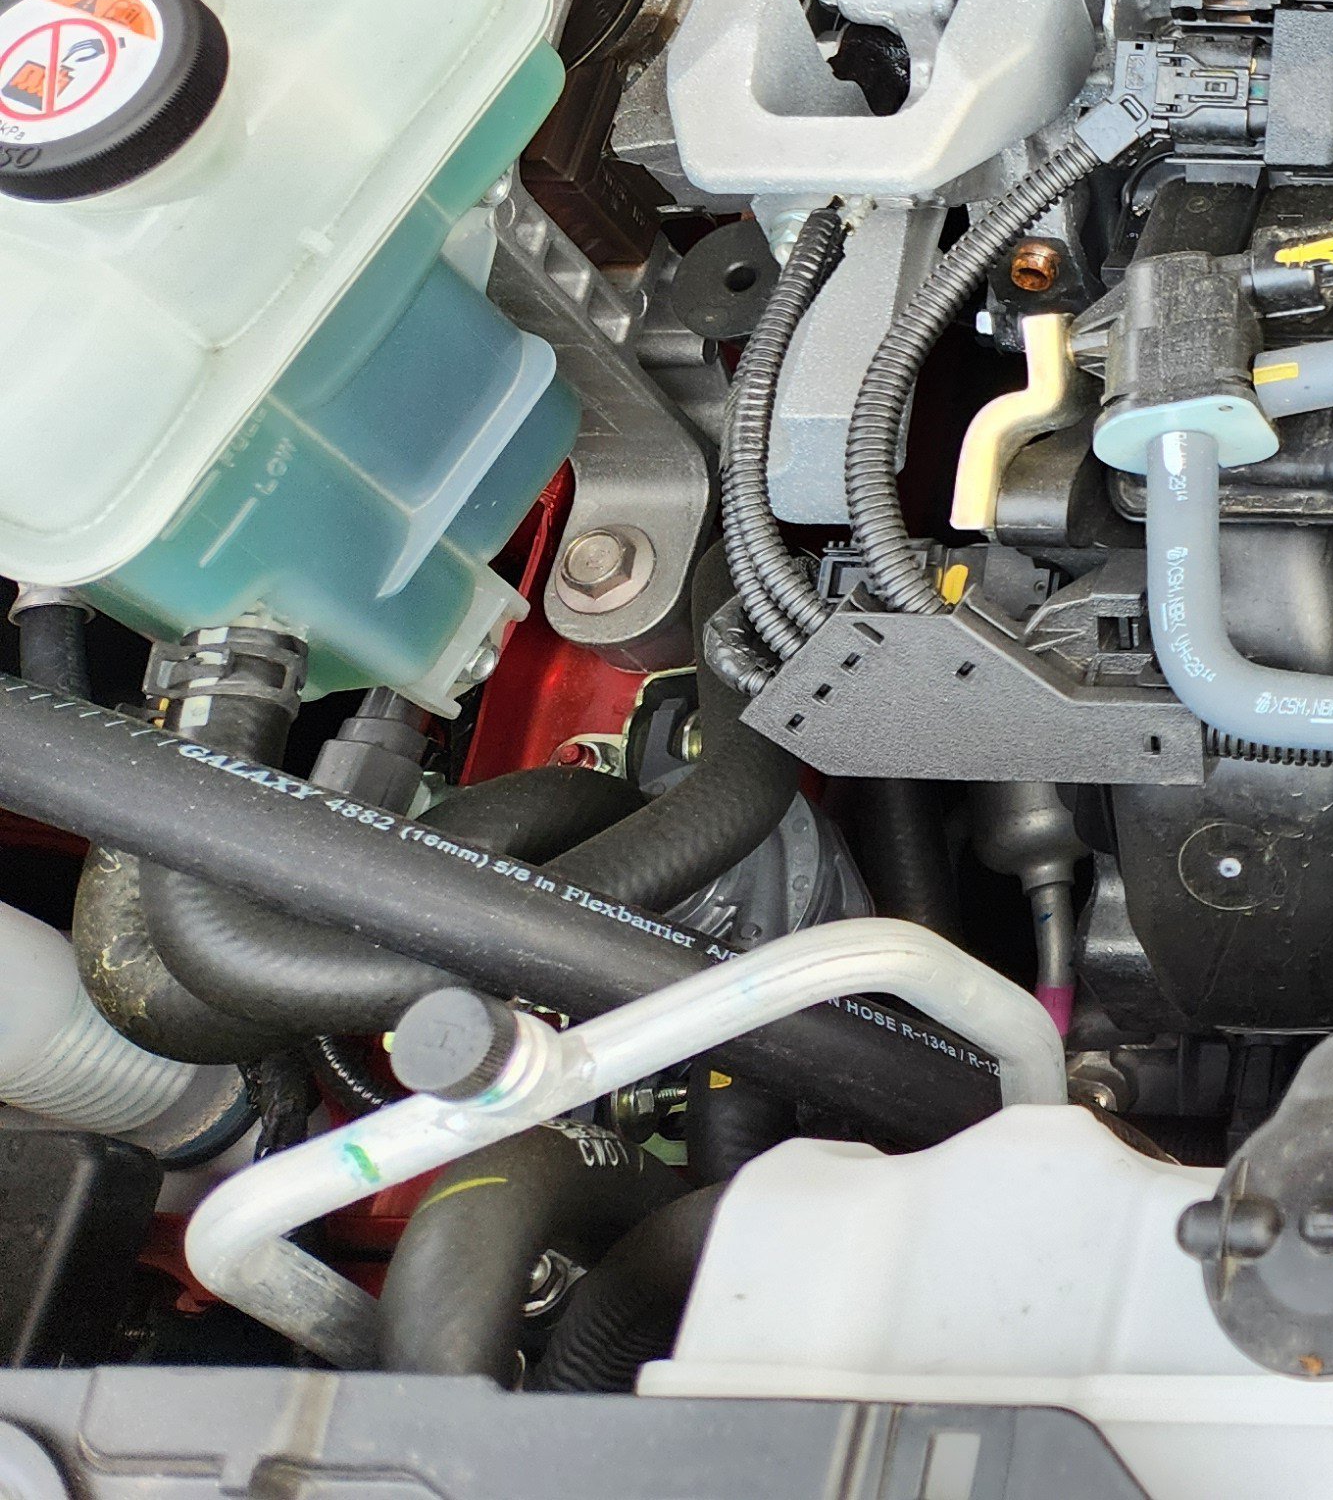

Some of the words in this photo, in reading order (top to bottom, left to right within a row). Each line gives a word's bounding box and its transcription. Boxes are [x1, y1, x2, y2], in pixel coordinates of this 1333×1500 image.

[256, 437, 299, 497] LOW
[178, 744, 325, 800] GALAXY
[325, 798, 395, 831] 4882
[398, 825, 489, 869] (16mm)
[491, 859, 531, 882] 5/8
[560, 883, 697, 949] Flexbarrier
[845, 1002, 898, 1033] HOSE
[901, 1022, 957, 1059] R-134a
